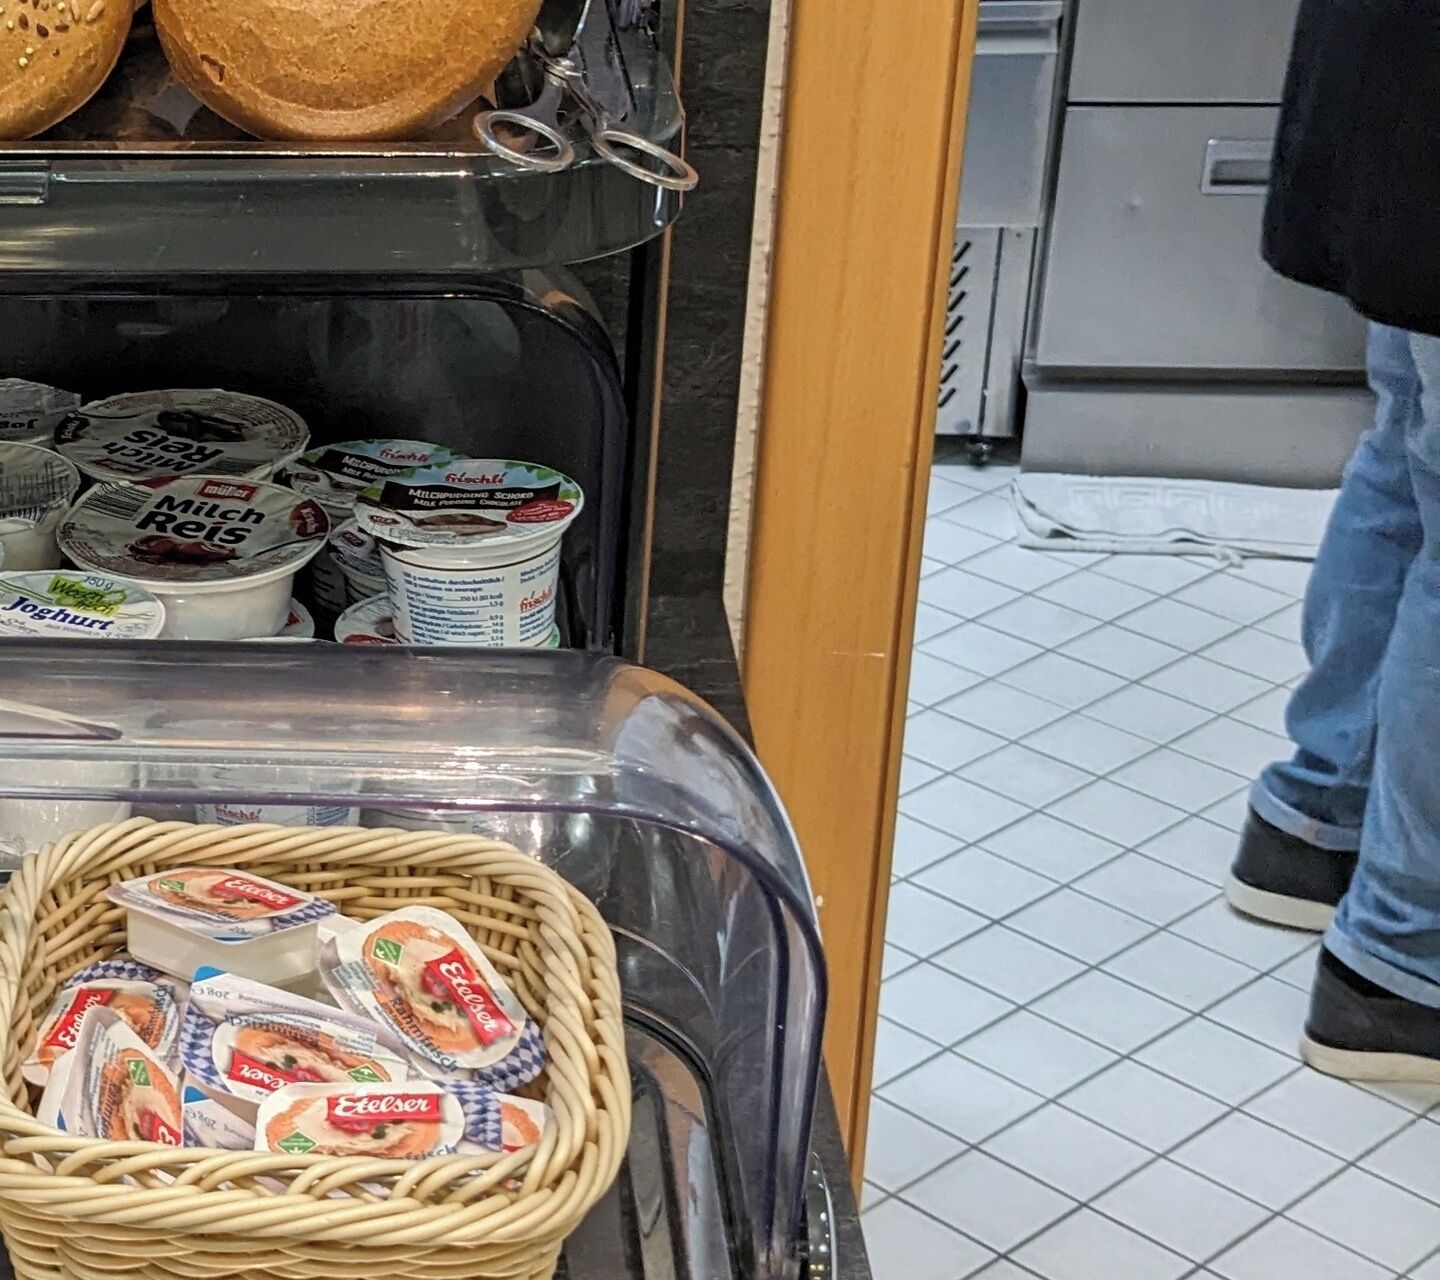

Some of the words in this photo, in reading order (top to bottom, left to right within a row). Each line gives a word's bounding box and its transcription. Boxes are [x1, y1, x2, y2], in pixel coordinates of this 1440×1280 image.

[101, 441, 196, 470] Milch
[124, 429, 224, 464] Reis
[203, 482, 249, 500] müller
[444, 471, 508, 485] frischli
[408, 488, 490, 499] MILCHPUDDING
[494, 491, 534, 499] SCHOKO
[413, 499, 437, 507] MILK
[439, 499, 476, 507] PUDDING
[153, 495, 265, 525] Milch
[135, 510, 252, 545] Reis
[83, 575, 103, 587] 150
[1, 595, 115, 631] Joghurt
[224, 879, 291, 905] Etelser
[438, 960, 501, 1035] Etelser
[388, 995, 460, 1074] Rahmfrisch
[334, 1094, 430, 1117] Etelser
